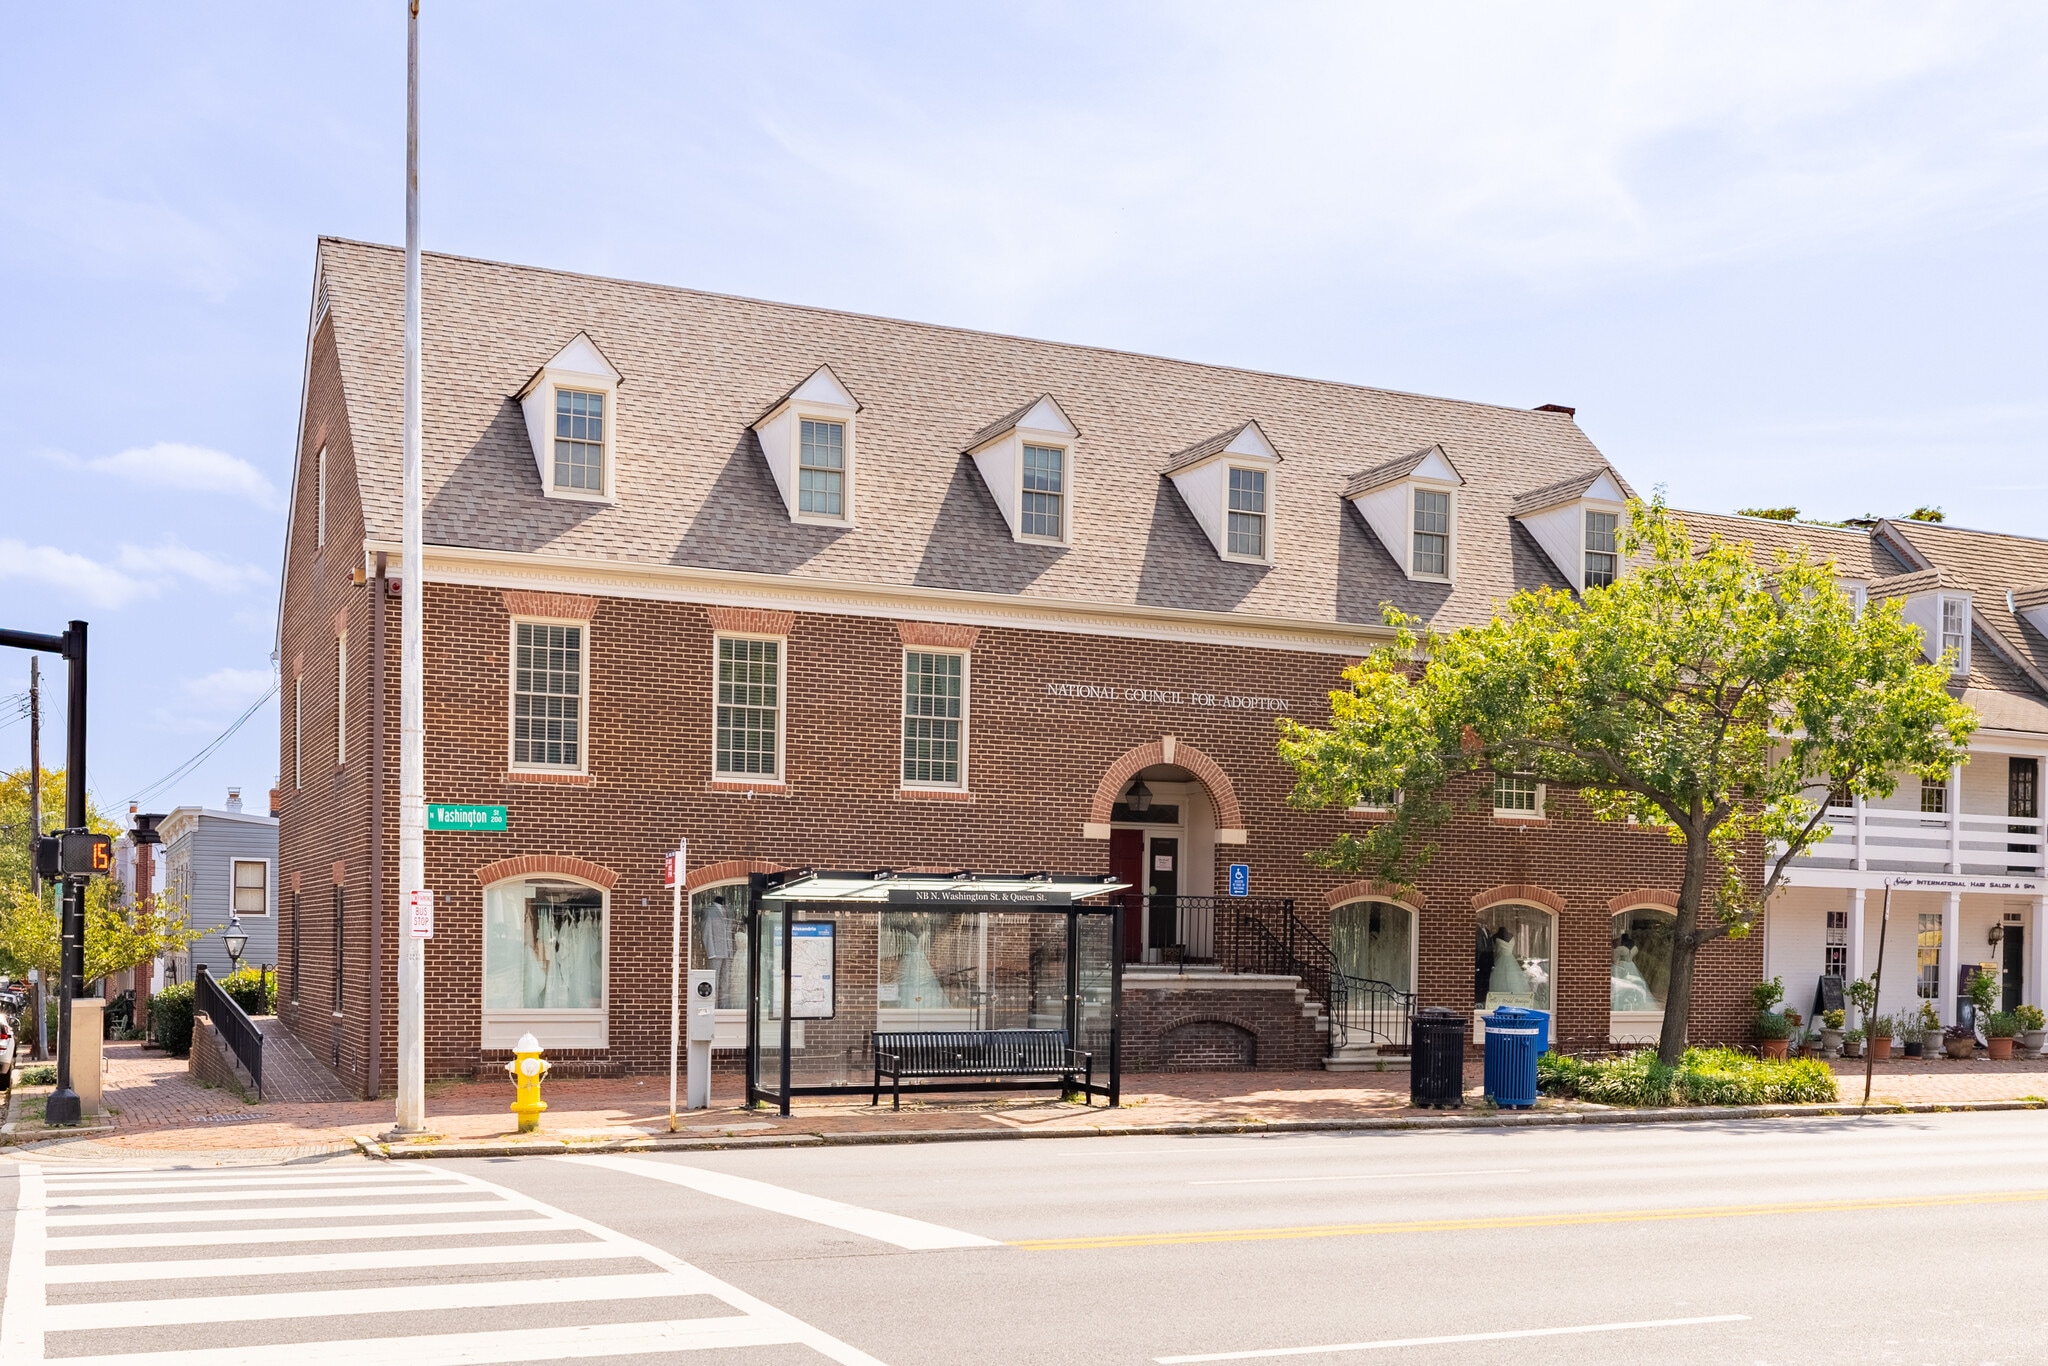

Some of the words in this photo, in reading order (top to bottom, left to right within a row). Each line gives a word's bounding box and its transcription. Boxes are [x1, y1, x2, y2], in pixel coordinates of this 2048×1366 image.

[1047, 683, 1119, 700] NATIONAL
[1124, 688, 1184, 704] COUNCIL
[1190, 693, 1216, 707] FOR
[1222, 695, 1289, 711] ADOPTION
[437, 807, 487, 828] Washington
[93, 843, 108, 869] 15
[916, 891, 929, 900] NB
[931, 892, 940, 900] N.
[941, 892, 988, 902] Washington
[990, 892, 1001, 901] St.
[1002, 893, 1009, 901] &
[1010, 893, 1035, 902] Queen
[1036, 893, 1047, 902] St.
[415, 906, 428, 916] BUS
[413, 916, 430, 926] STOP
